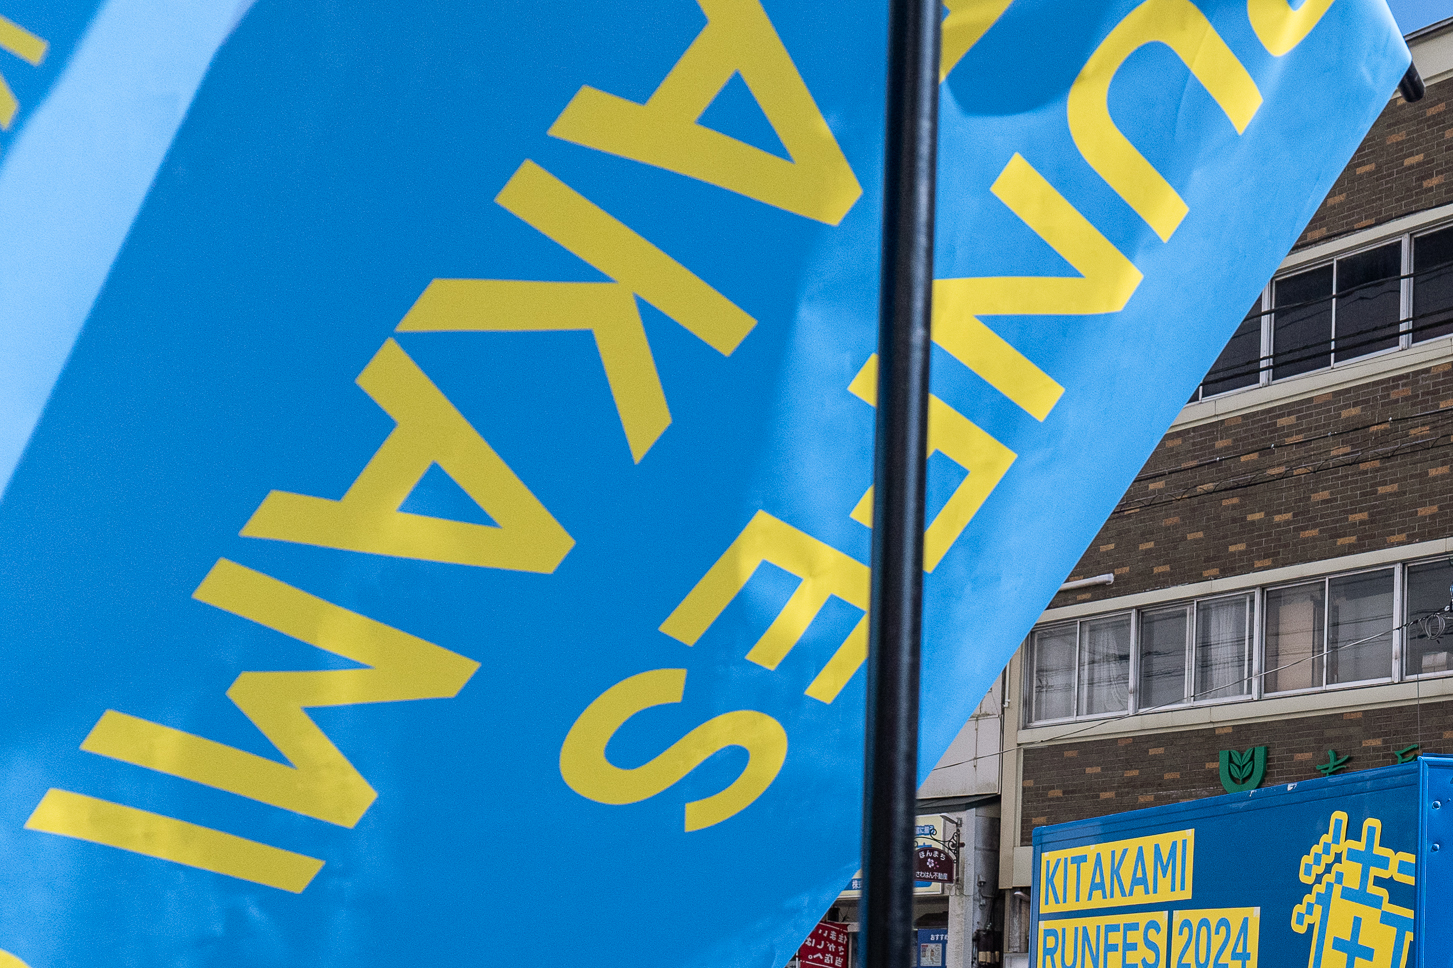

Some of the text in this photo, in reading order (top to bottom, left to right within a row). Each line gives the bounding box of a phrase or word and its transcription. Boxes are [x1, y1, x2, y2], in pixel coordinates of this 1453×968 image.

[24, 0, 1007, 893] AKAMI
[558, 0, 1340, 832] UNFES
[1044, 838, 1188, 906] KITAKAMI
